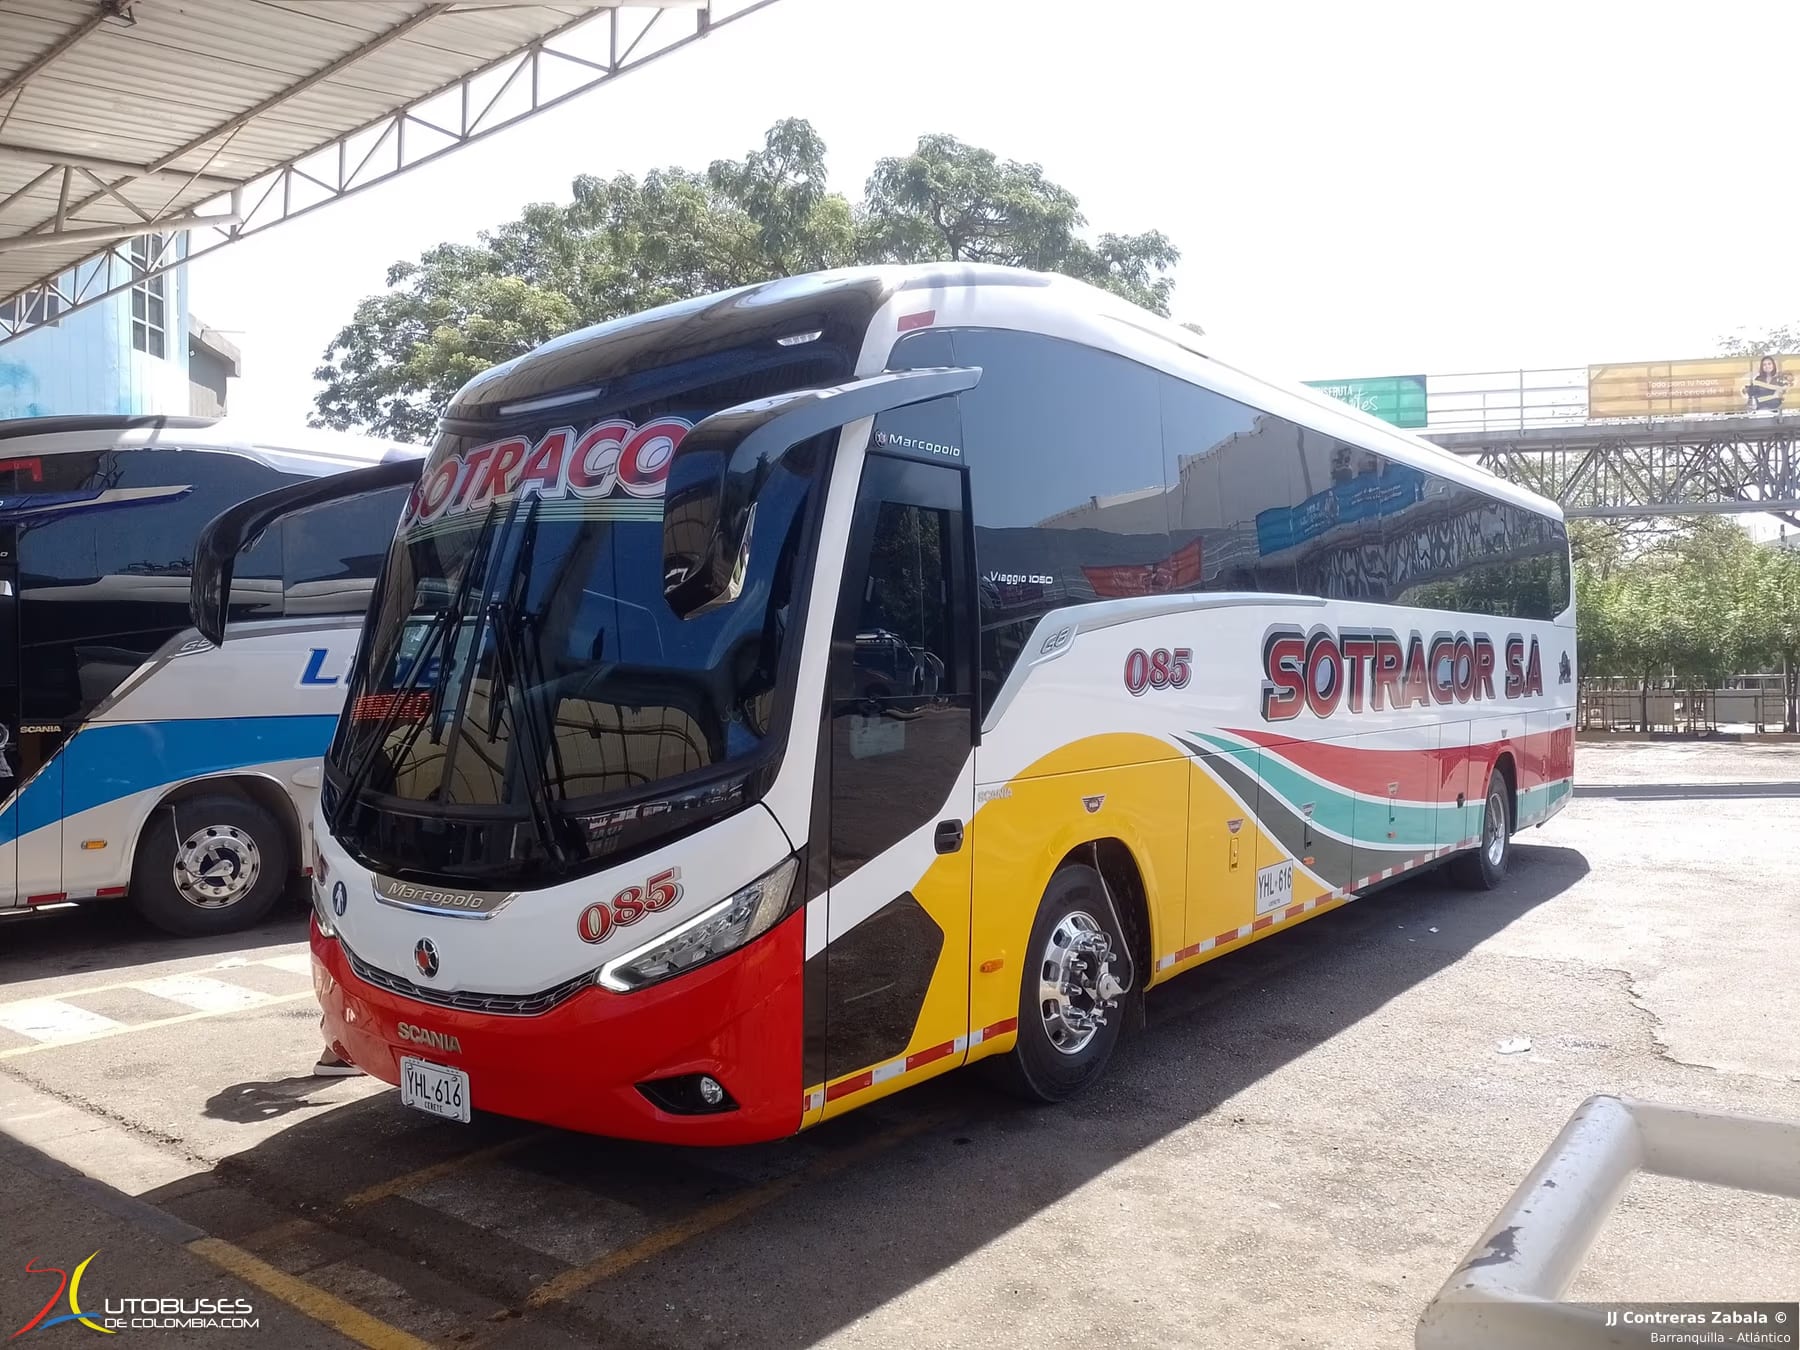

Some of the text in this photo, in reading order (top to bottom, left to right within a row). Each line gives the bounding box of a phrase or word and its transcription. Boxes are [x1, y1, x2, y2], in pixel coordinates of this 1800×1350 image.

[889, 433, 960, 457] Marcopolo
[401, 416, 696, 528] SOTRACO
[990, 571, 1054, 585] Viaggio 1050
[1124, 647, 1194, 698] 085
[1260, 622, 1496, 722] SOTRACOR
[20, 725, 62, 734] SCANIA
[977, 786, 1013, 803] SCANIA
[387, 881, 484, 909] Marcopolo
[576, 866, 684, 945] 085
[397, 1021, 463, 1055] SCANIA
